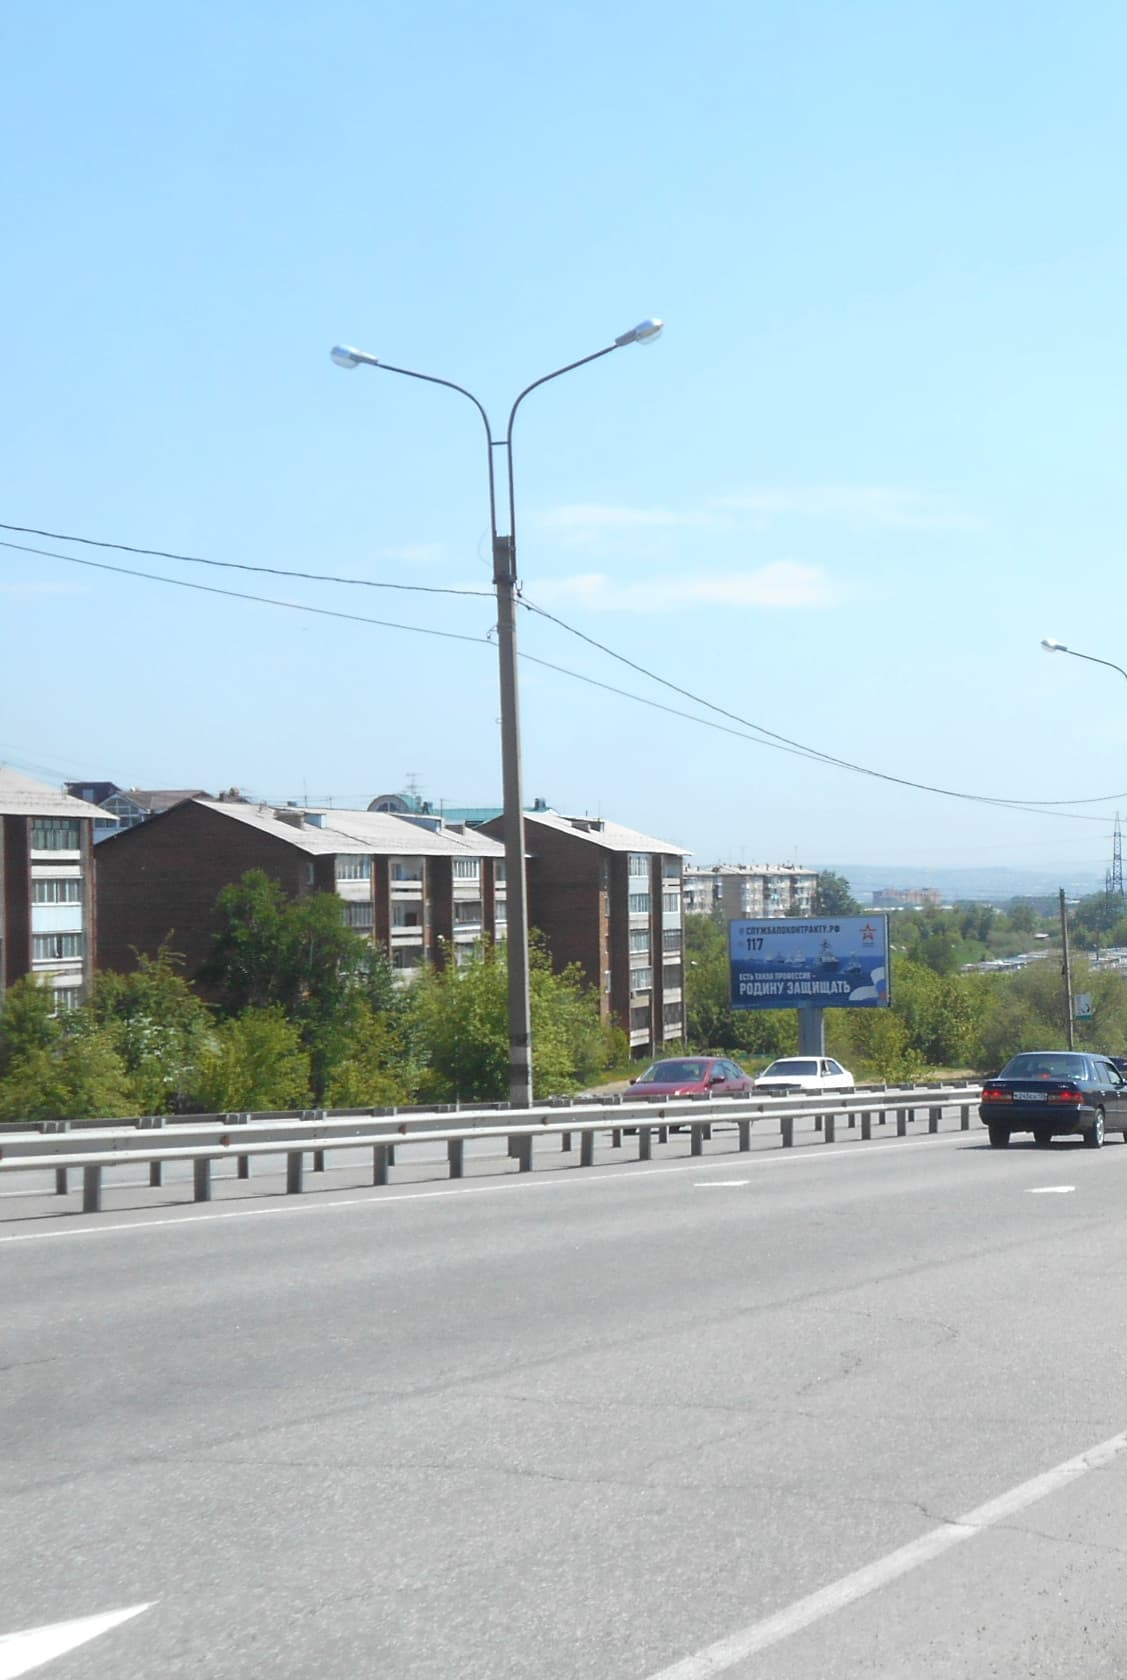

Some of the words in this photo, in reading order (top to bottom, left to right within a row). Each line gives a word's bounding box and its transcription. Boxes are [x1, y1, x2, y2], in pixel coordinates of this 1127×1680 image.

[746, 938, 764, 951] 117
[739, 982, 784, 996] РОДИНУ
[787, 981, 851, 995] ЗАЩИЩАТЬ
